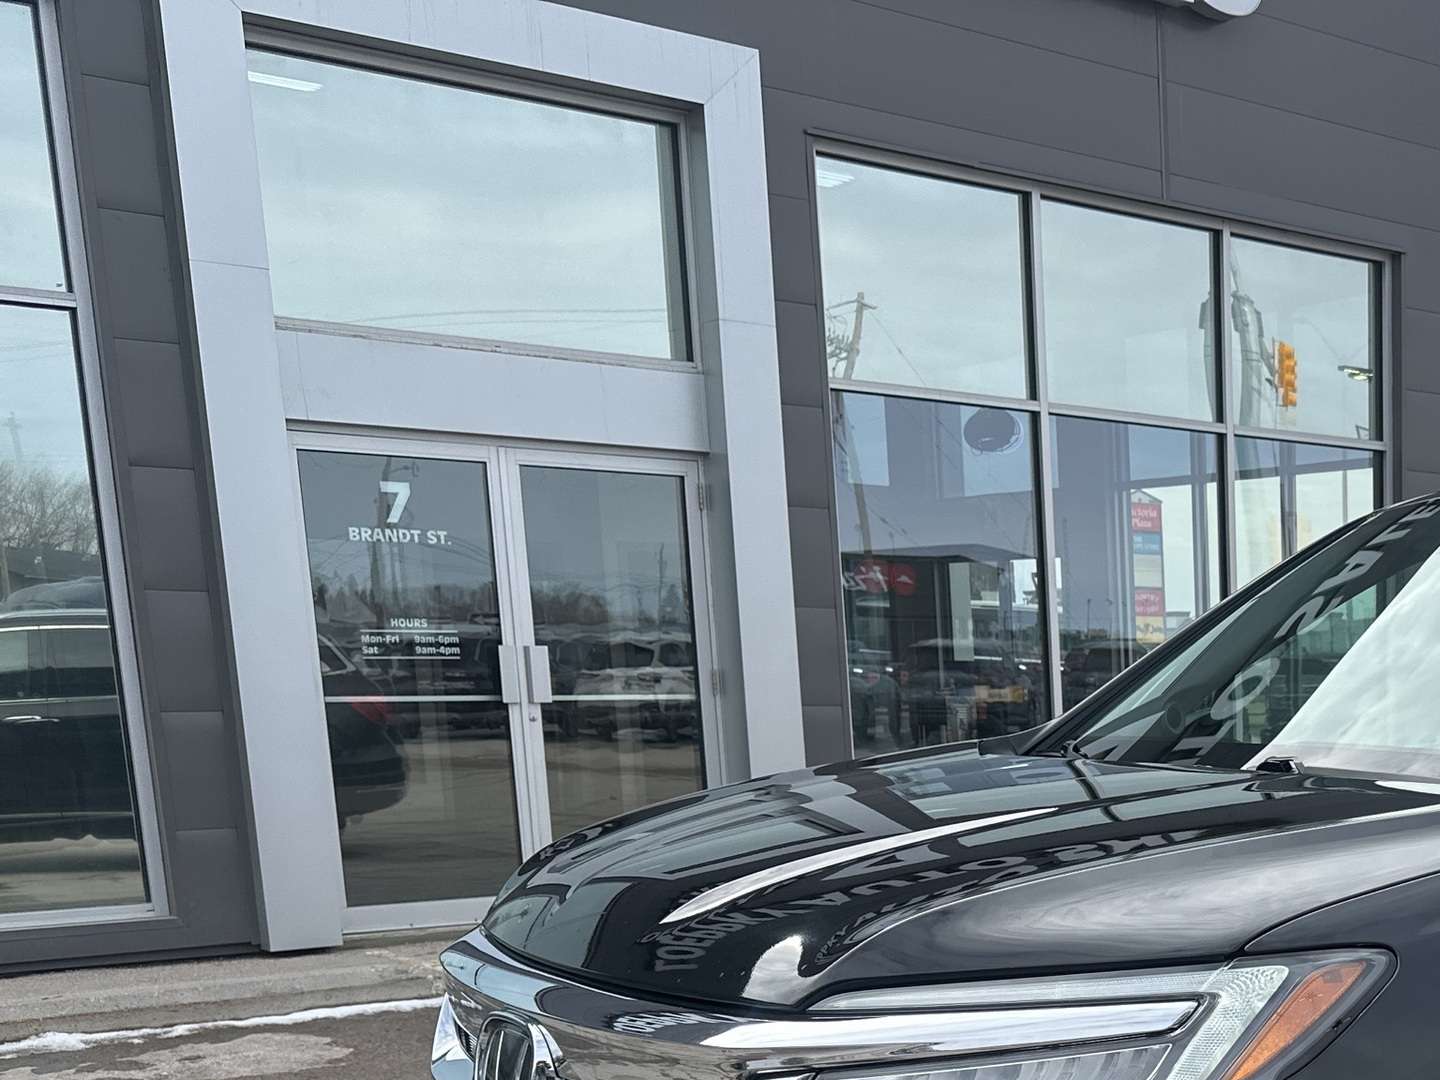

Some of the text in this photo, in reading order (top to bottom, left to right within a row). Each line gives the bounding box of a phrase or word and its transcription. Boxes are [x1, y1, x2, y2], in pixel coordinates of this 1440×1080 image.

[379, 480, 411, 523] 7
[348, 527, 452, 545] BRANDT ST.
[390, 618, 428, 628] HOURS
[361, 634, 399, 644] Mon-Fri
[362, 645, 460, 656] Sat 9am-4pm
